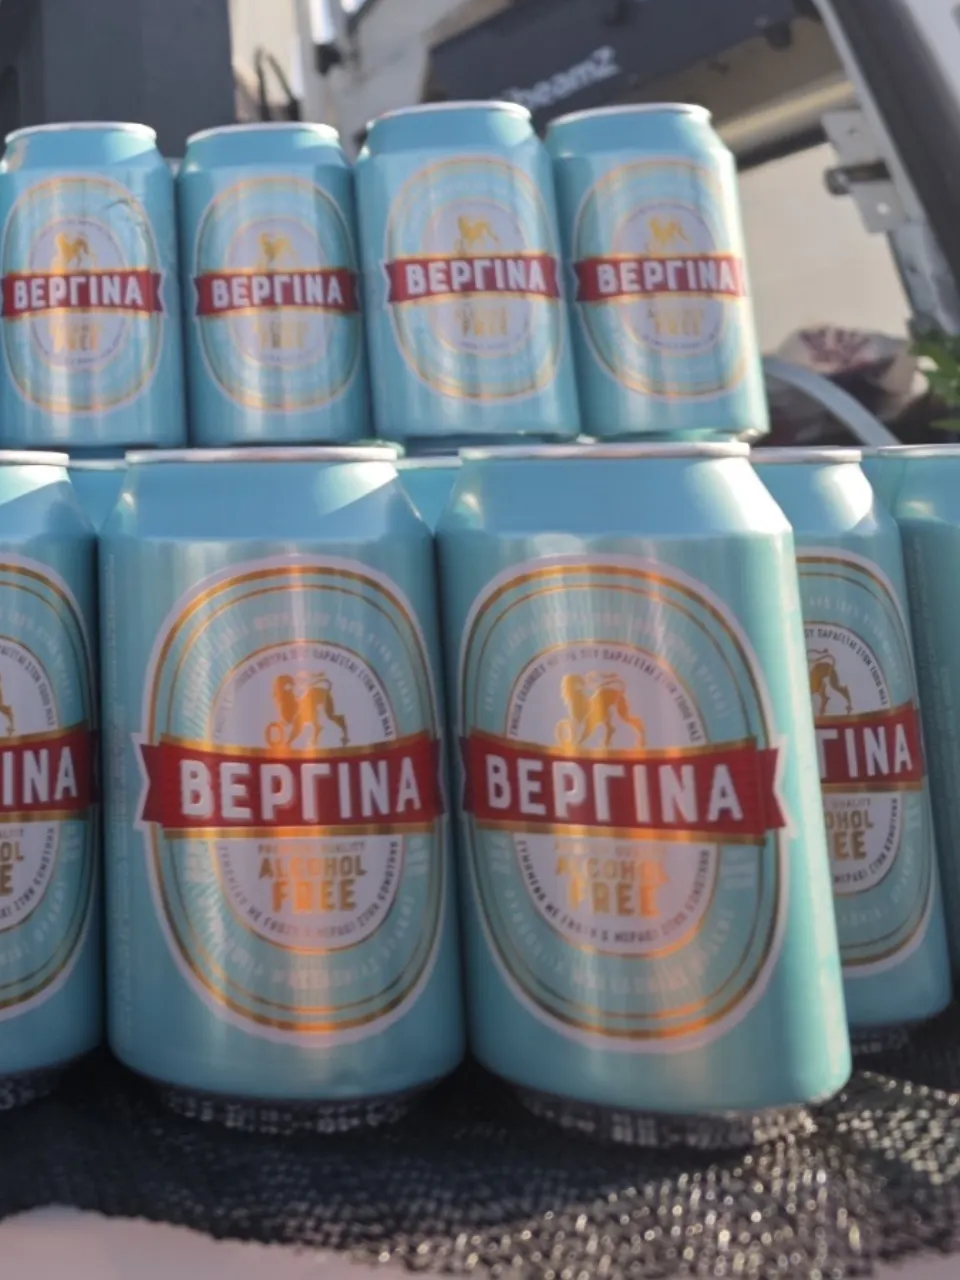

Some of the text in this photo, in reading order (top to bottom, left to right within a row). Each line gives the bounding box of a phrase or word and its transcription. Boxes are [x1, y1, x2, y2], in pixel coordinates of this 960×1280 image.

[180, 757, 422, 823] ΒΕΡΓΙΝΑ
[486, 754, 743, 824] ΒΕΡΓΙΝΑ
[833, 830, 868, 860] EE
[258, 855, 368, 880] ALCOHOL
[272, 879, 357, 914] FREE
